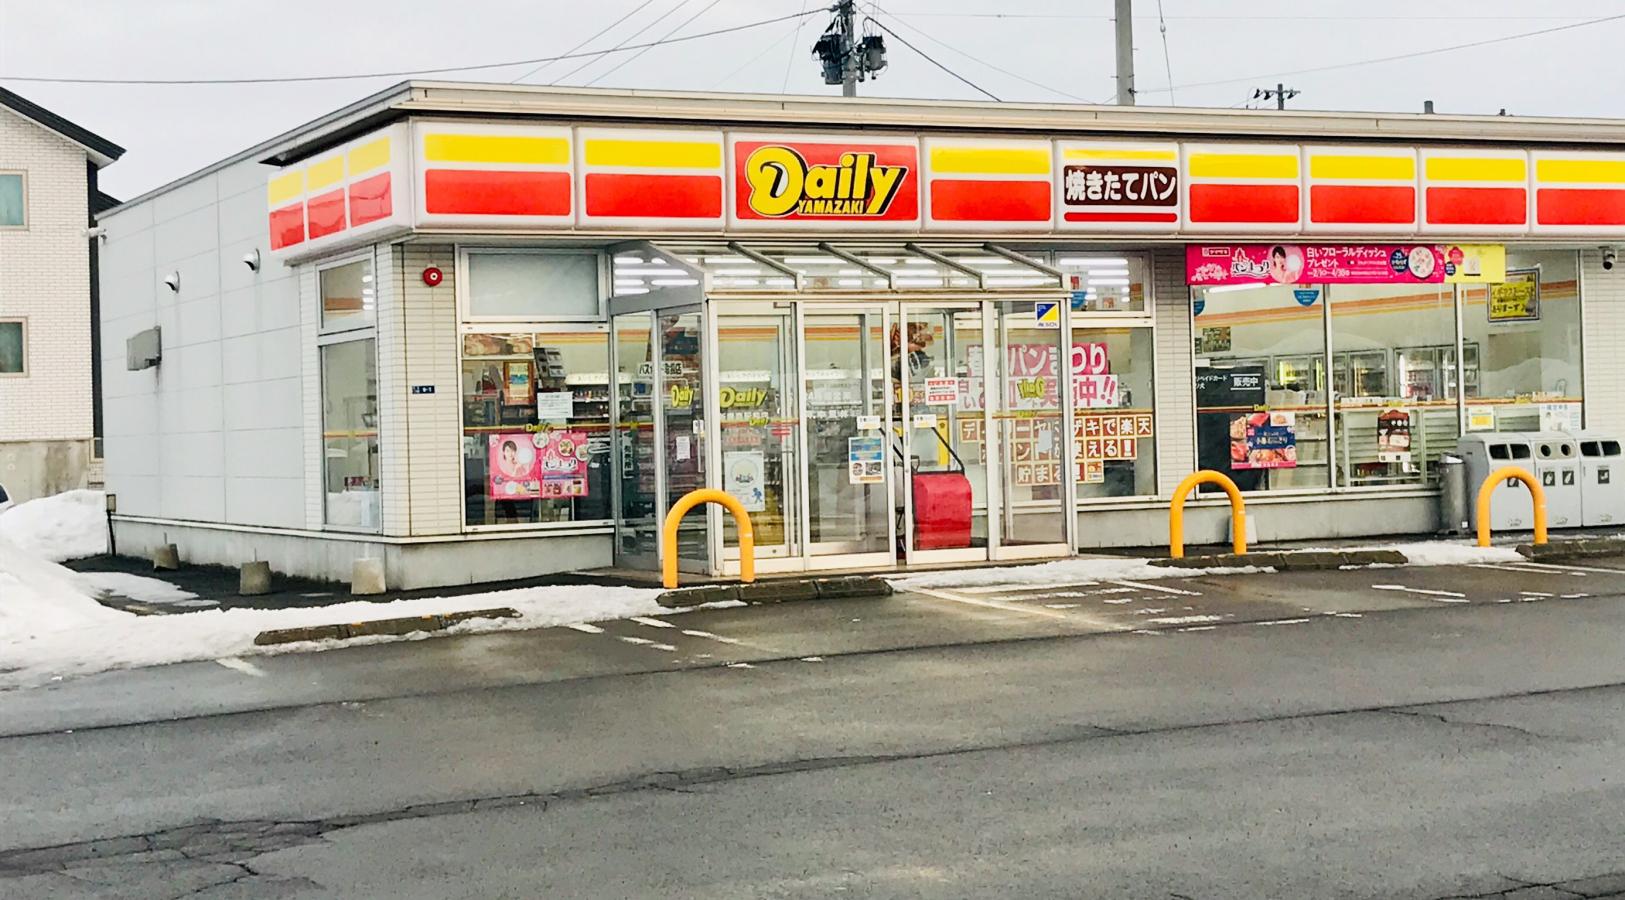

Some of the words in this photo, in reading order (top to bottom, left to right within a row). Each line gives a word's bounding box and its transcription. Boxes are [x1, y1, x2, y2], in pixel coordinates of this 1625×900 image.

[746, 145, 908, 217] Daily
[1065, 170, 1176, 201] 焼きたてパン
[797, 200, 864, 214] YAMAZAKI
[1306, 246, 1387, 258] 白いフローラルディッシュ
[1307, 258, 1339, 268] プレゼント
[1233, 377, 1259, 387] 販売中
[671, 385, 694, 408] Daily
[720, 386, 769, 408] Daily
